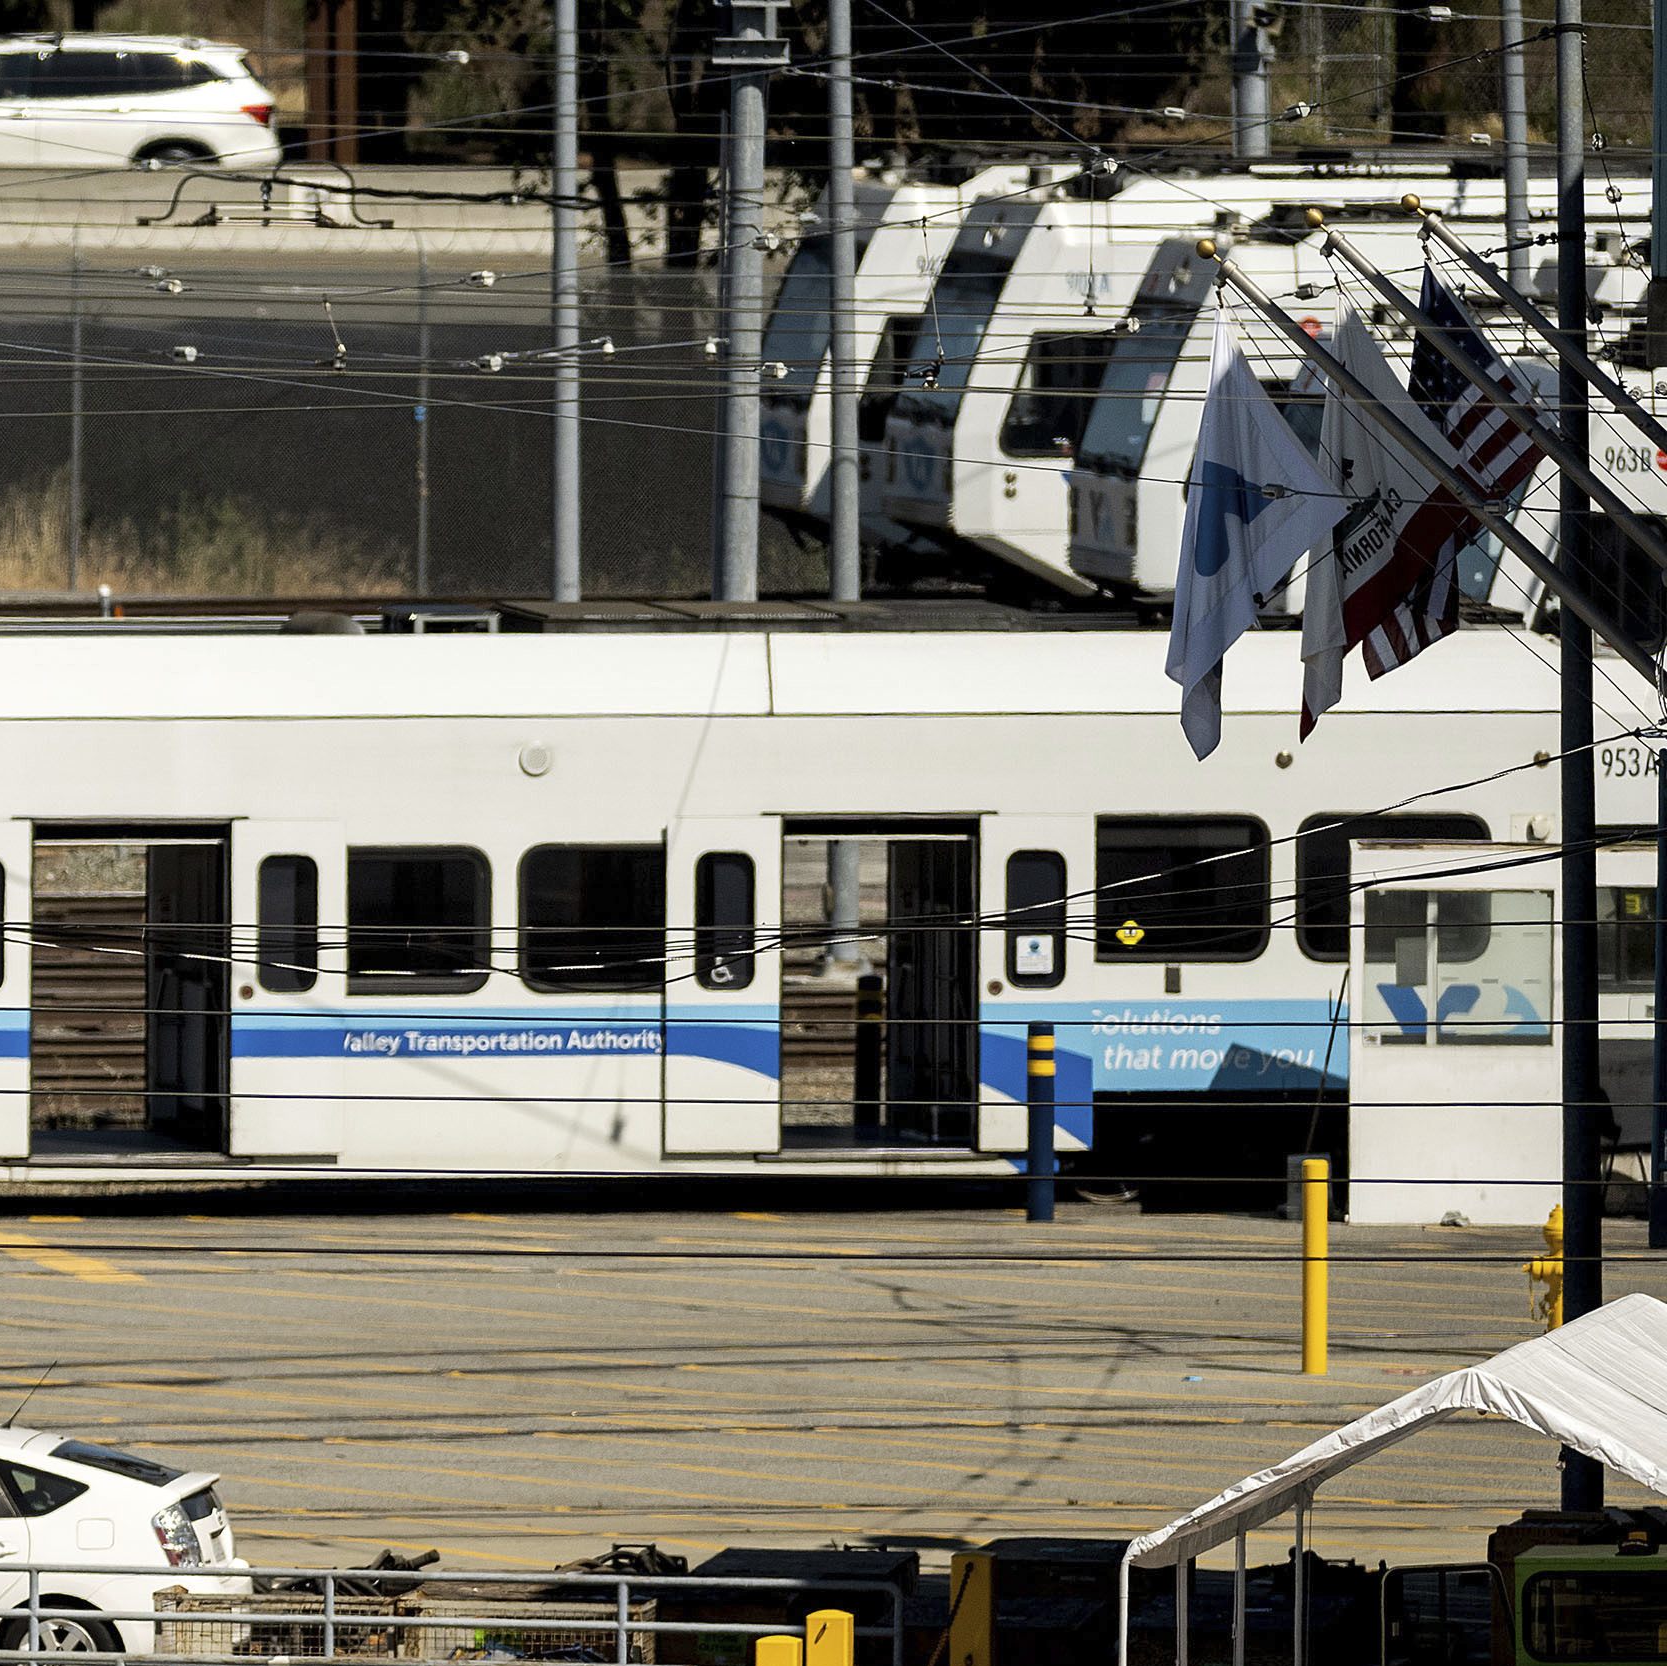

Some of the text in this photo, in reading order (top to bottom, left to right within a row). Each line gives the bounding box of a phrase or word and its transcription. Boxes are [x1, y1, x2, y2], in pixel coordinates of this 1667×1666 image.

[1605, 446, 1652, 473] 963B
[1601, 747, 1659, 778] 953A
[405, 1030, 563, 1055] Transportation
[567, 1029, 662, 1054] Authority
[1103, 1043, 1316, 1076] that move you
